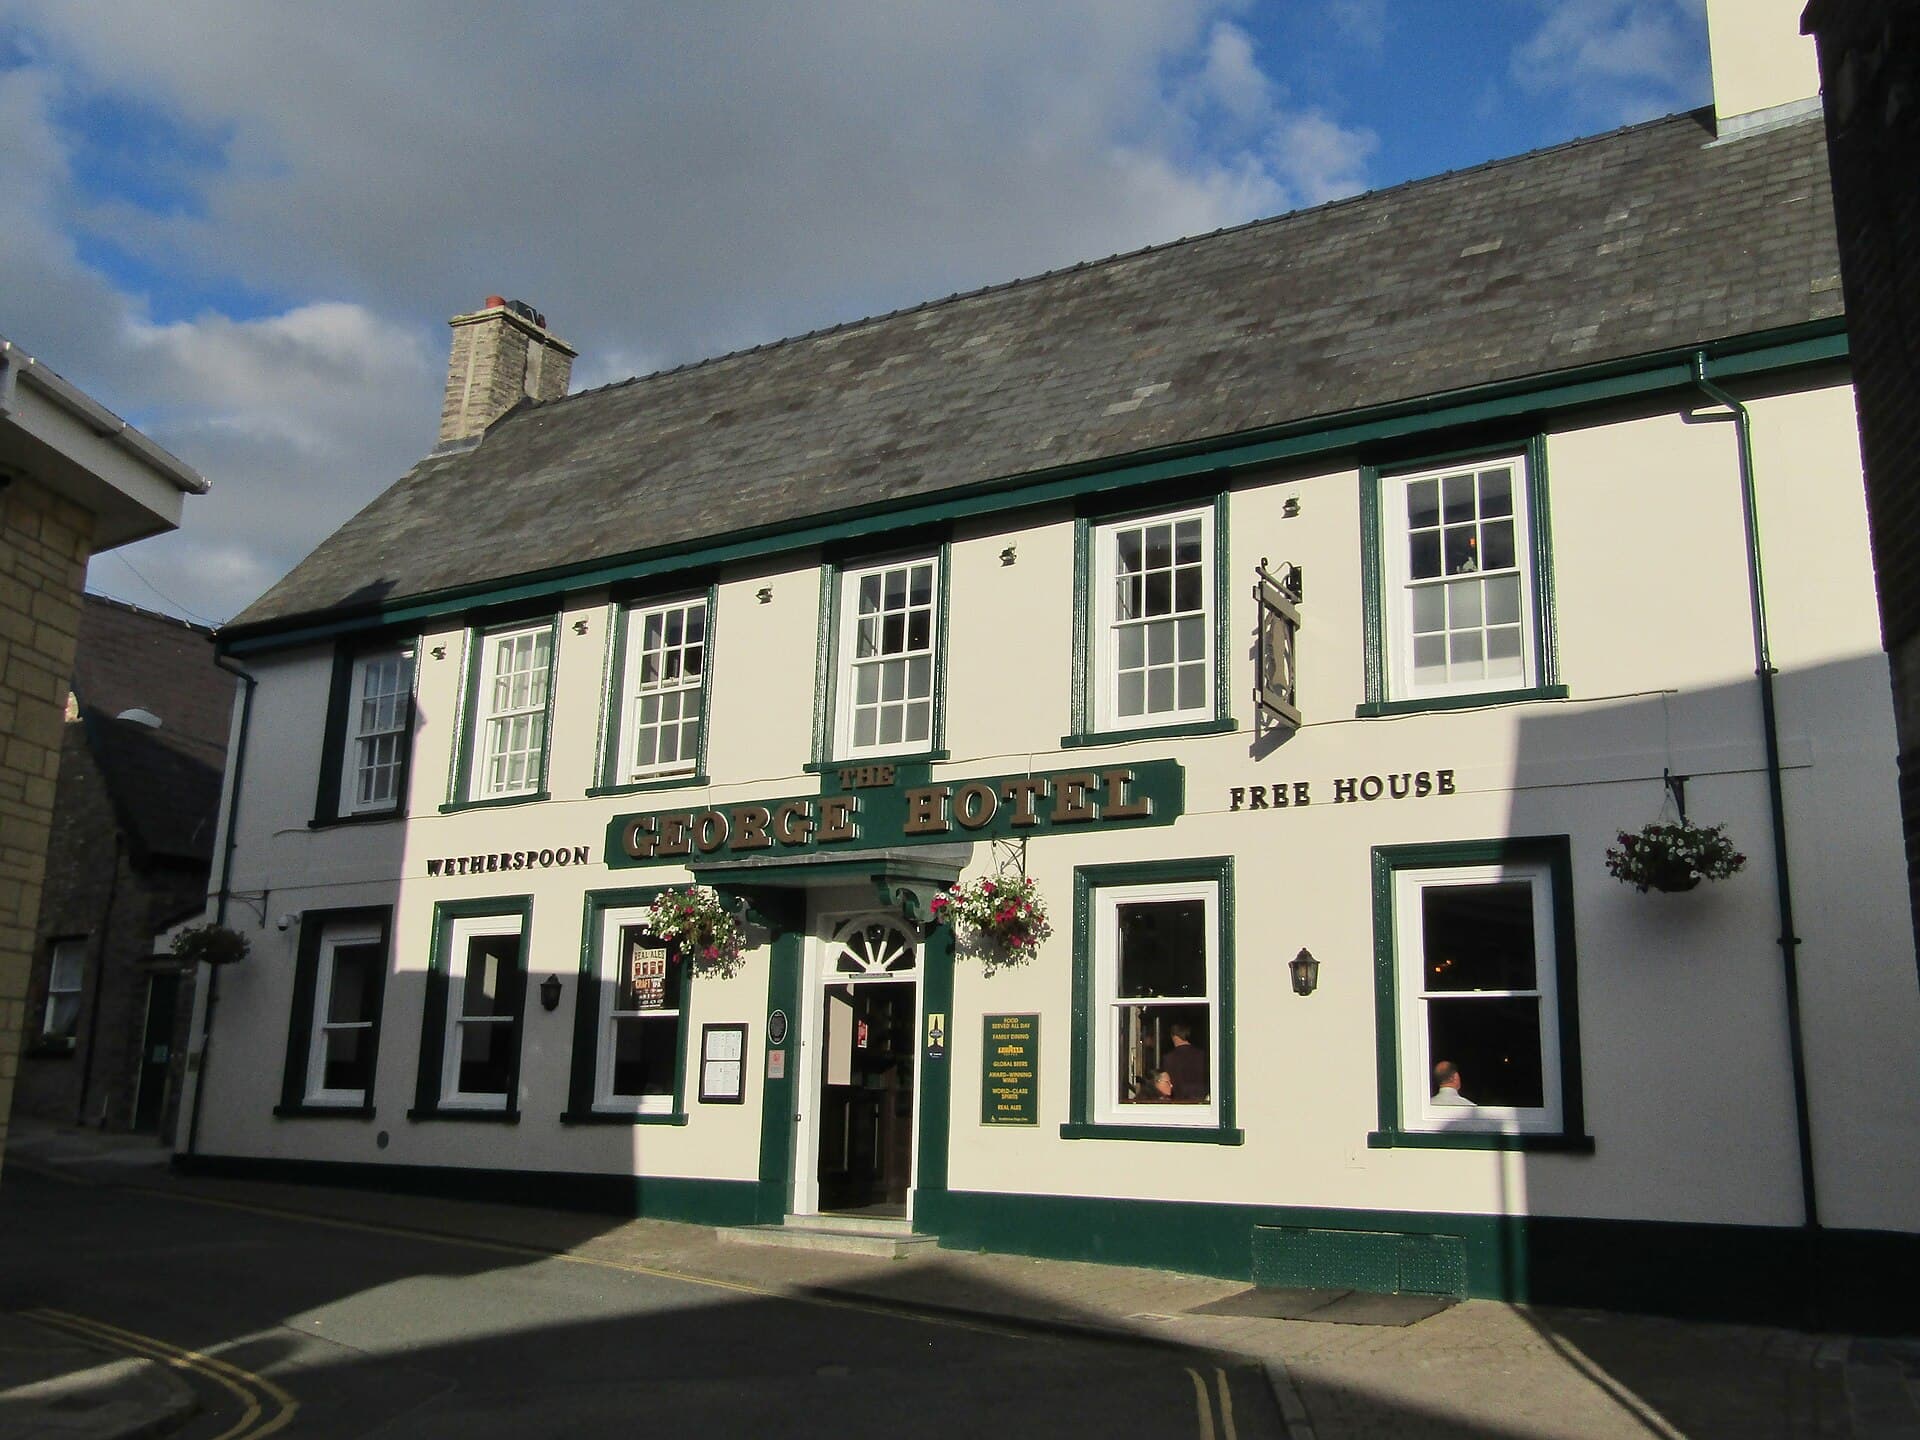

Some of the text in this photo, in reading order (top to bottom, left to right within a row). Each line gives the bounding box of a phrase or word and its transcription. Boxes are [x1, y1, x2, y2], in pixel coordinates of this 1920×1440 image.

[838, 764, 895, 789] THE
[1230, 769, 1456, 811] FREE HOUSE
[622, 769, 1151, 859] GEORGE HOTEL
[427, 846, 590, 877] WETHERSPOON
[635, 950, 665, 960] REAL ALES
[635, 979, 651, 988] CRAFT
